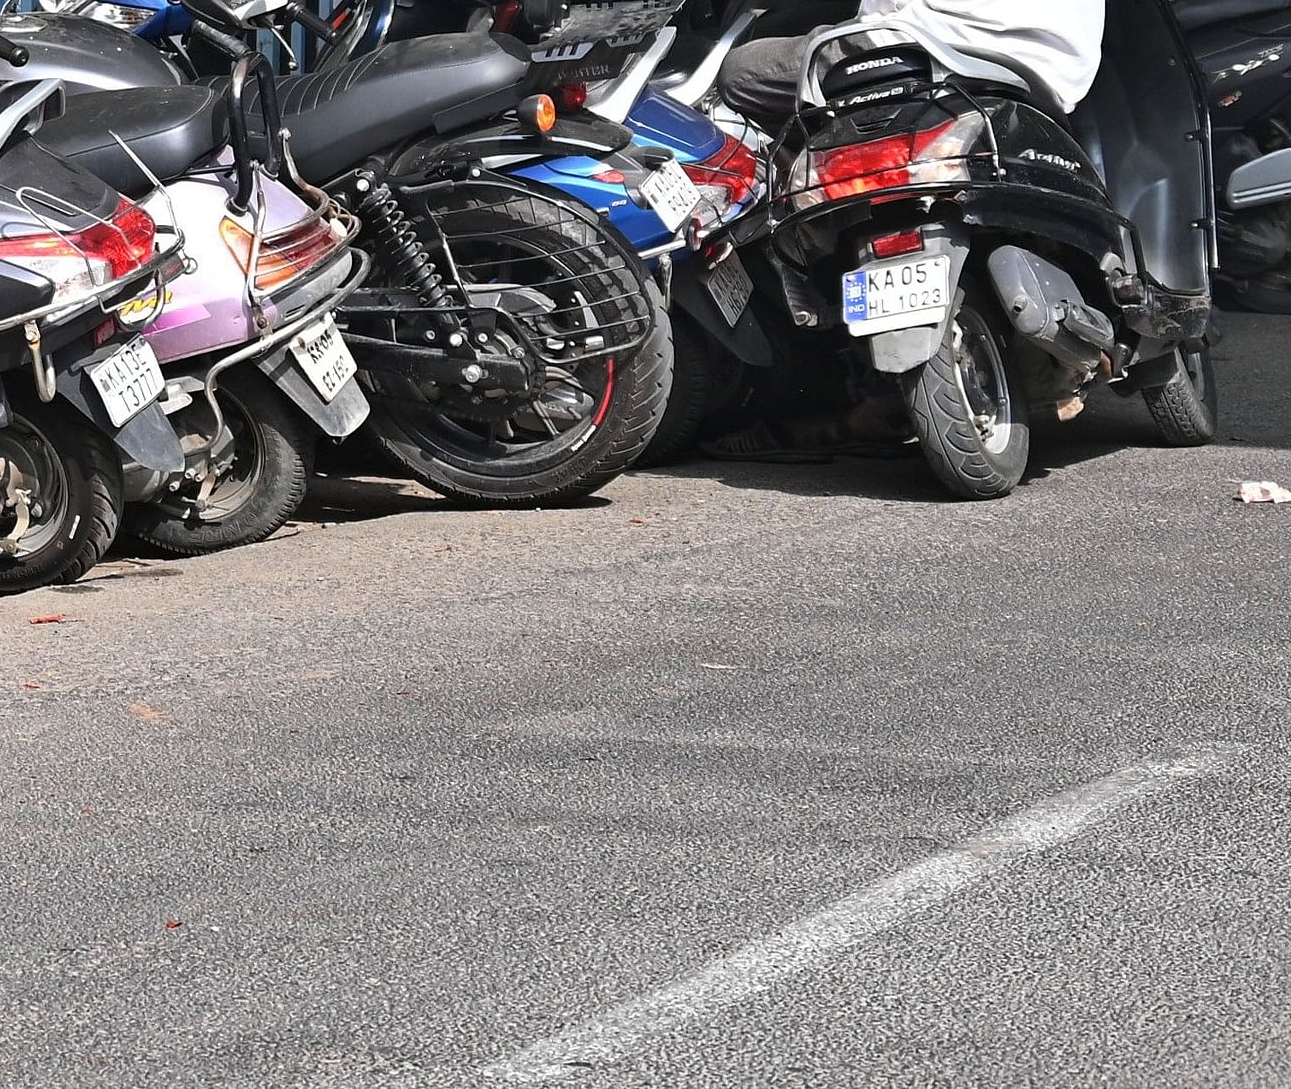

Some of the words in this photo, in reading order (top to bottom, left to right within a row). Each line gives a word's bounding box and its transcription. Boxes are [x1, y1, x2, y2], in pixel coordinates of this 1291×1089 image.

[845, 56, 905, 75] HONDA
[849, 91, 891, 105] Activa
[869, 269, 894, 292] KA
[902, 263, 927, 286] 05
[869, 299, 890, 317] HL
[899, 288, 941, 310] 1023
[104, 343, 147, 390] KA13E
[118, 367, 158, 413] T3777
